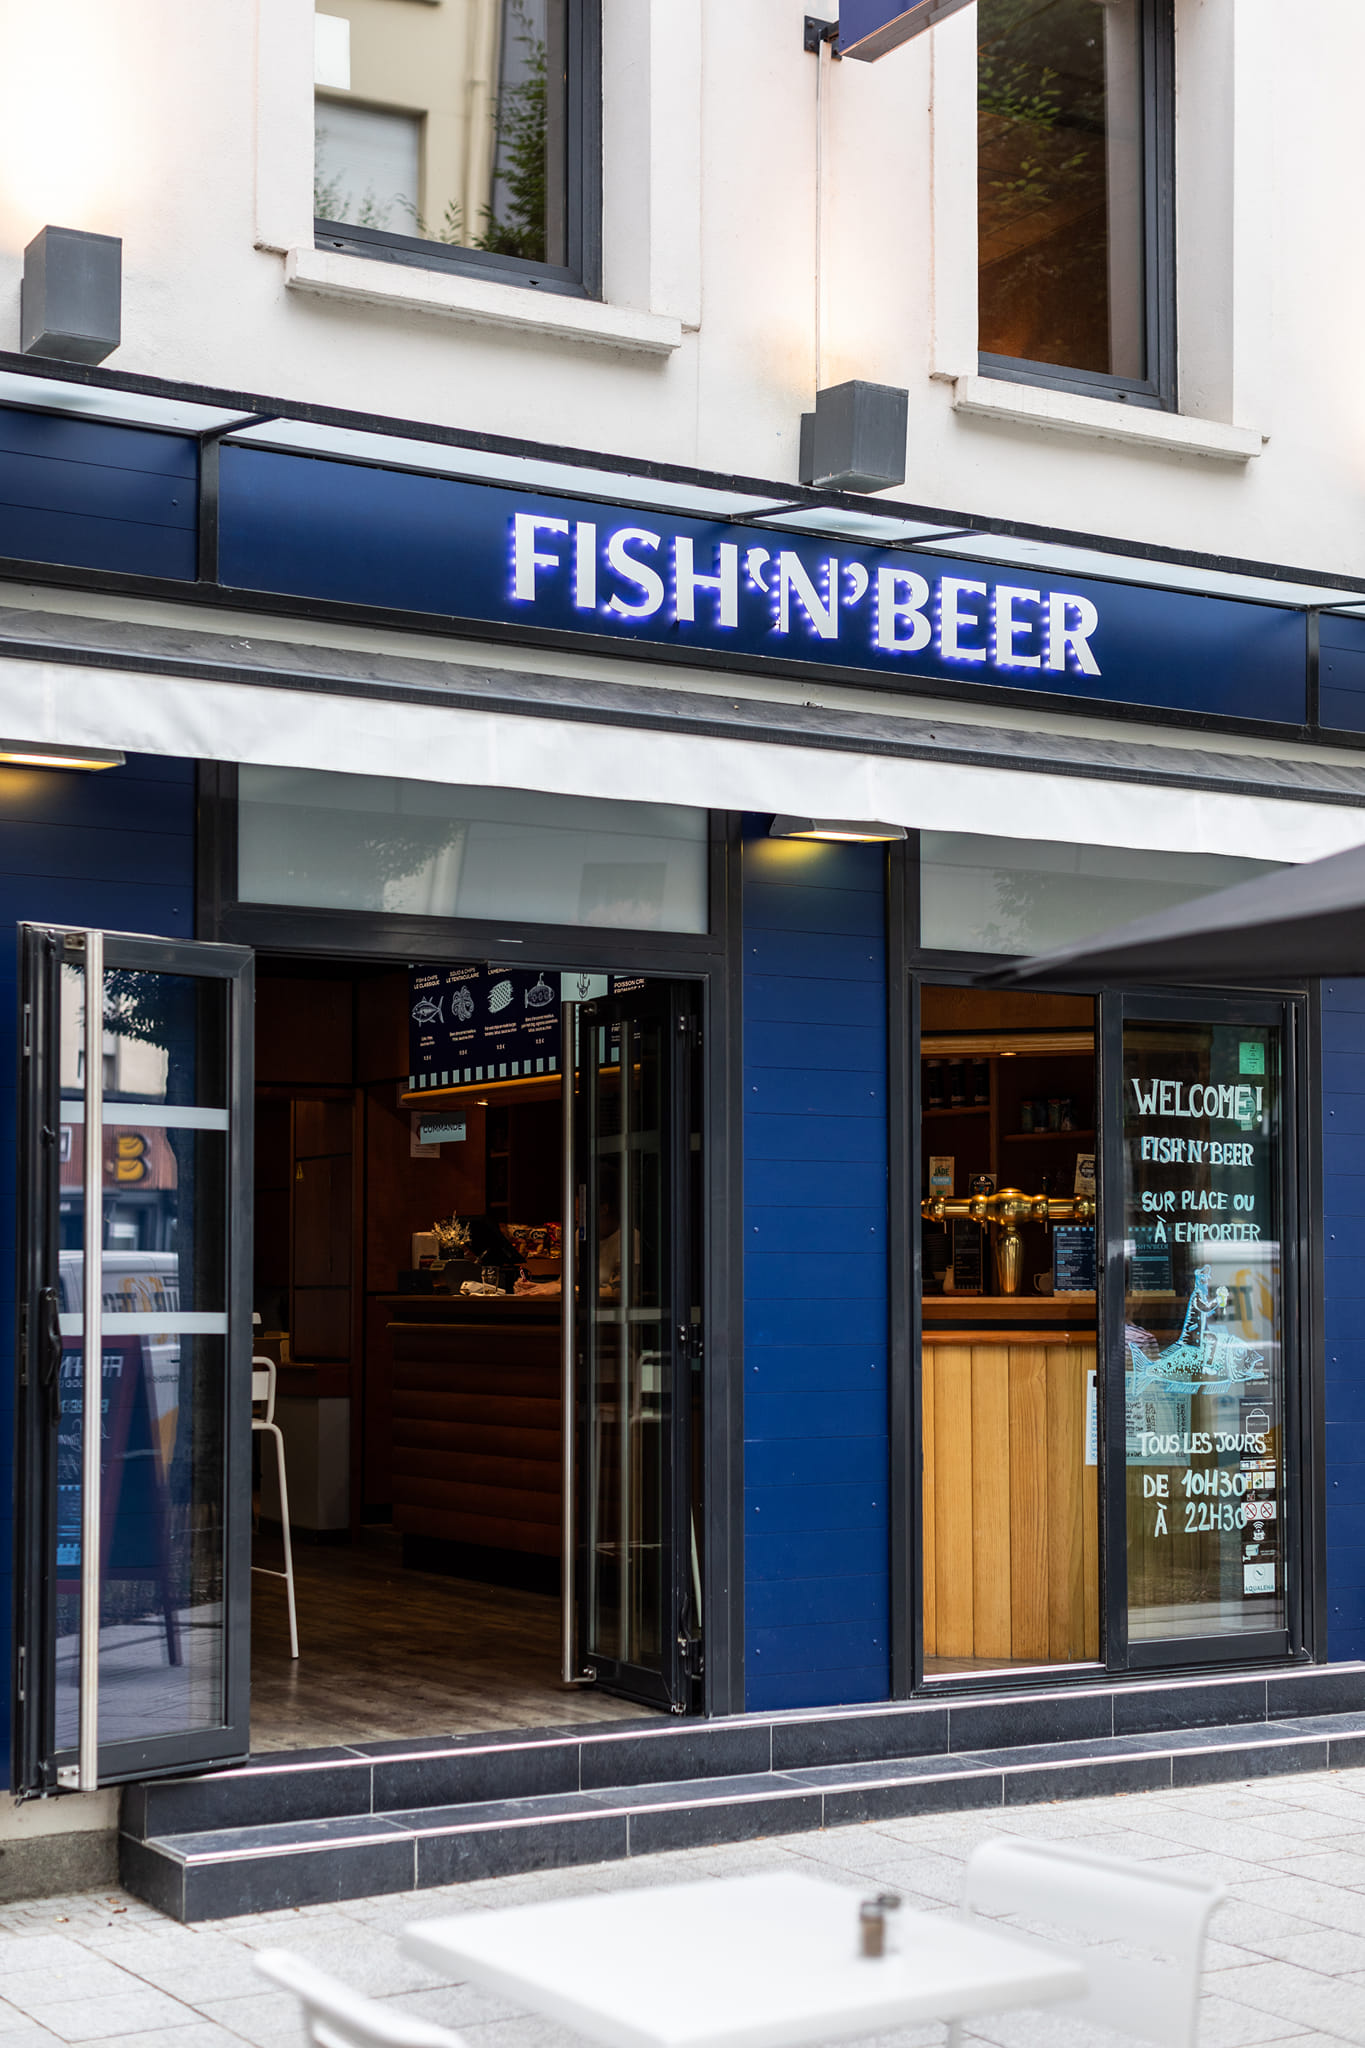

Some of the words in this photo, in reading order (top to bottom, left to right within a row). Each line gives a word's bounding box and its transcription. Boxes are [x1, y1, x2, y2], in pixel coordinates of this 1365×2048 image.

[1141, 1190, 1176, 1213] SUR
[1181, 1190, 1229, 1211] PLACE
[1233, 1193, 1255, 1212] OU
[1154, 1214, 1168, 1243] À
[1175, 1221, 1261, 1243] EMPORTER
[1137, 1430, 1180, 1456] TOUS
[1183, 1431, 1212, 1455] LES
[1213, 1431, 1267, 1454] JOURS
[1143, 1474, 1169, 1498] DE
[1181, 1469, 1248, 1498] 10H30
[1154, 1501, 1168, 1538] À
[1184, 1502, 1248, 1533] 22H30
